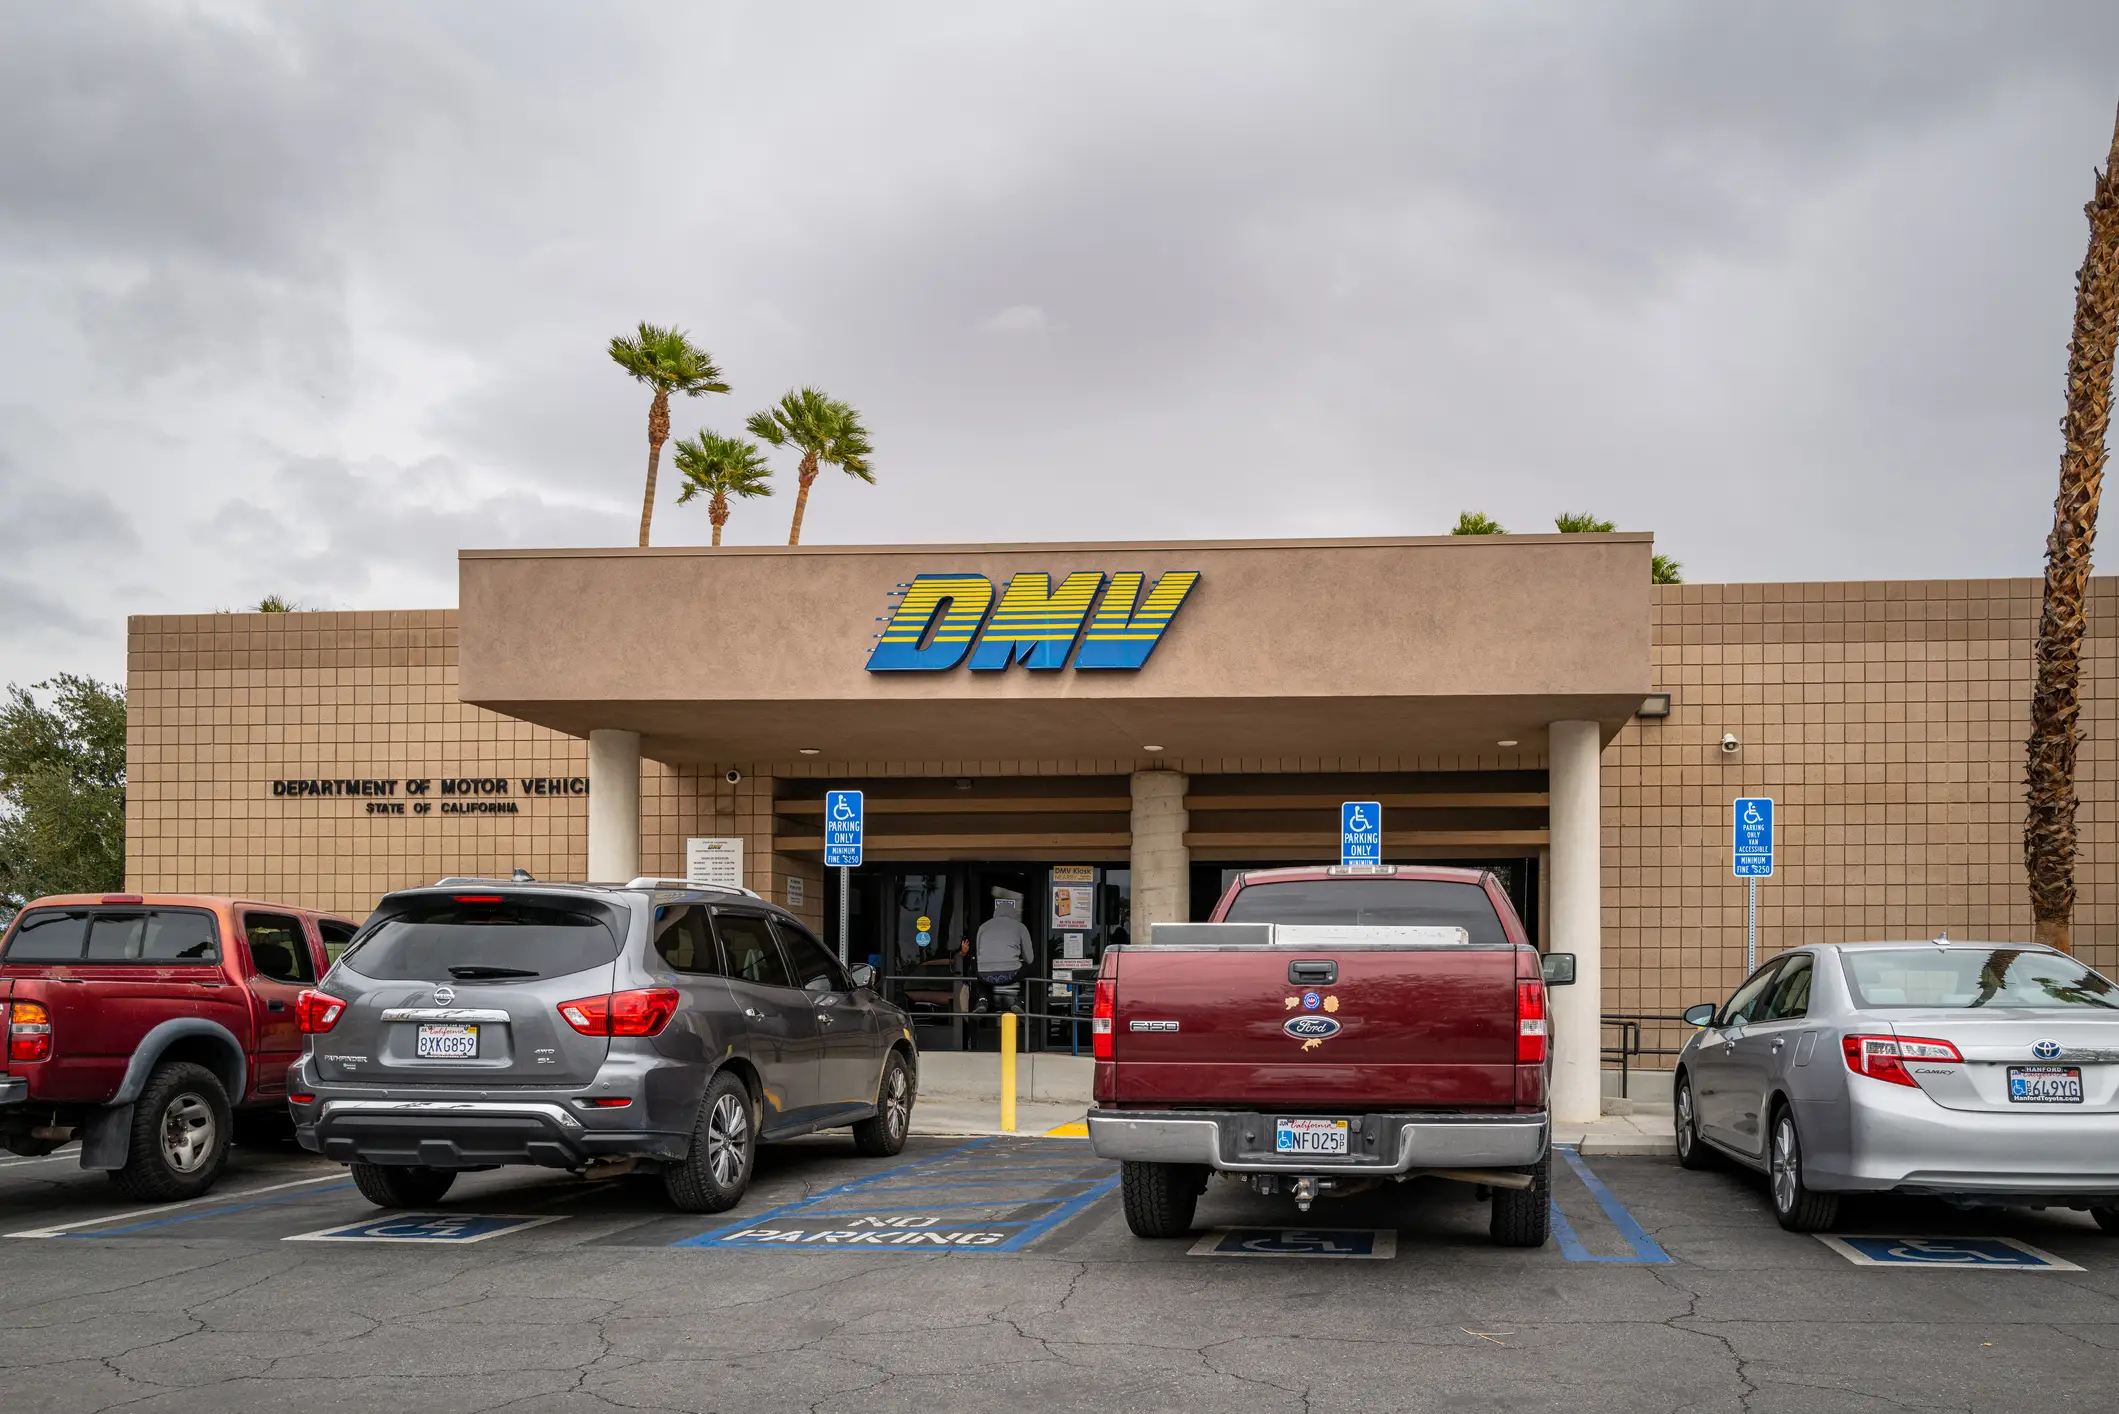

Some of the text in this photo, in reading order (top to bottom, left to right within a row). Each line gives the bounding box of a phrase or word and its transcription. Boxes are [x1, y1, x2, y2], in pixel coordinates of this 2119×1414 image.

[864, 571, 1202, 673] DMV
[272, 779, 398, 796] DEPARTMENT
[405, 778, 431, 796] OF
[441, 778, 508, 795] MOTOR
[365, 801, 519, 813] STATE OF CALIFORNIA
[828, 821, 860, 831] PARKING
[834, 833, 854, 843] ONLY
[1344, 832, 1378, 844] PARKING
[1351, 845, 1372, 856] ONLY
[827, 855, 859, 863] FINE $250
[1740, 856, 1766, 864] MINIMUM
[1073, 867, 1092, 875] Kiosk
[1736, 865, 1770, 874] FINE $250
[429, 1026, 464, 1036] California
[1296, 1019, 1327, 1033] Ford
[420, 1037, 475, 1052] 8XKG859
[324, 1054, 368, 1063] PATHFINDER
[1915, 1068, 1955, 1076] CAMRY
[2033, 1080, 2078, 1096] 649YG
[2014, 1095, 2080, 1103] HanfordToyota.com
[1290, 1119, 1334, 1131] California
[1292, 1132, 1339, 1150] NF025
[846, 1215, 942, 1228] NO
[719, 1229, 1004, 1245] PARKING
